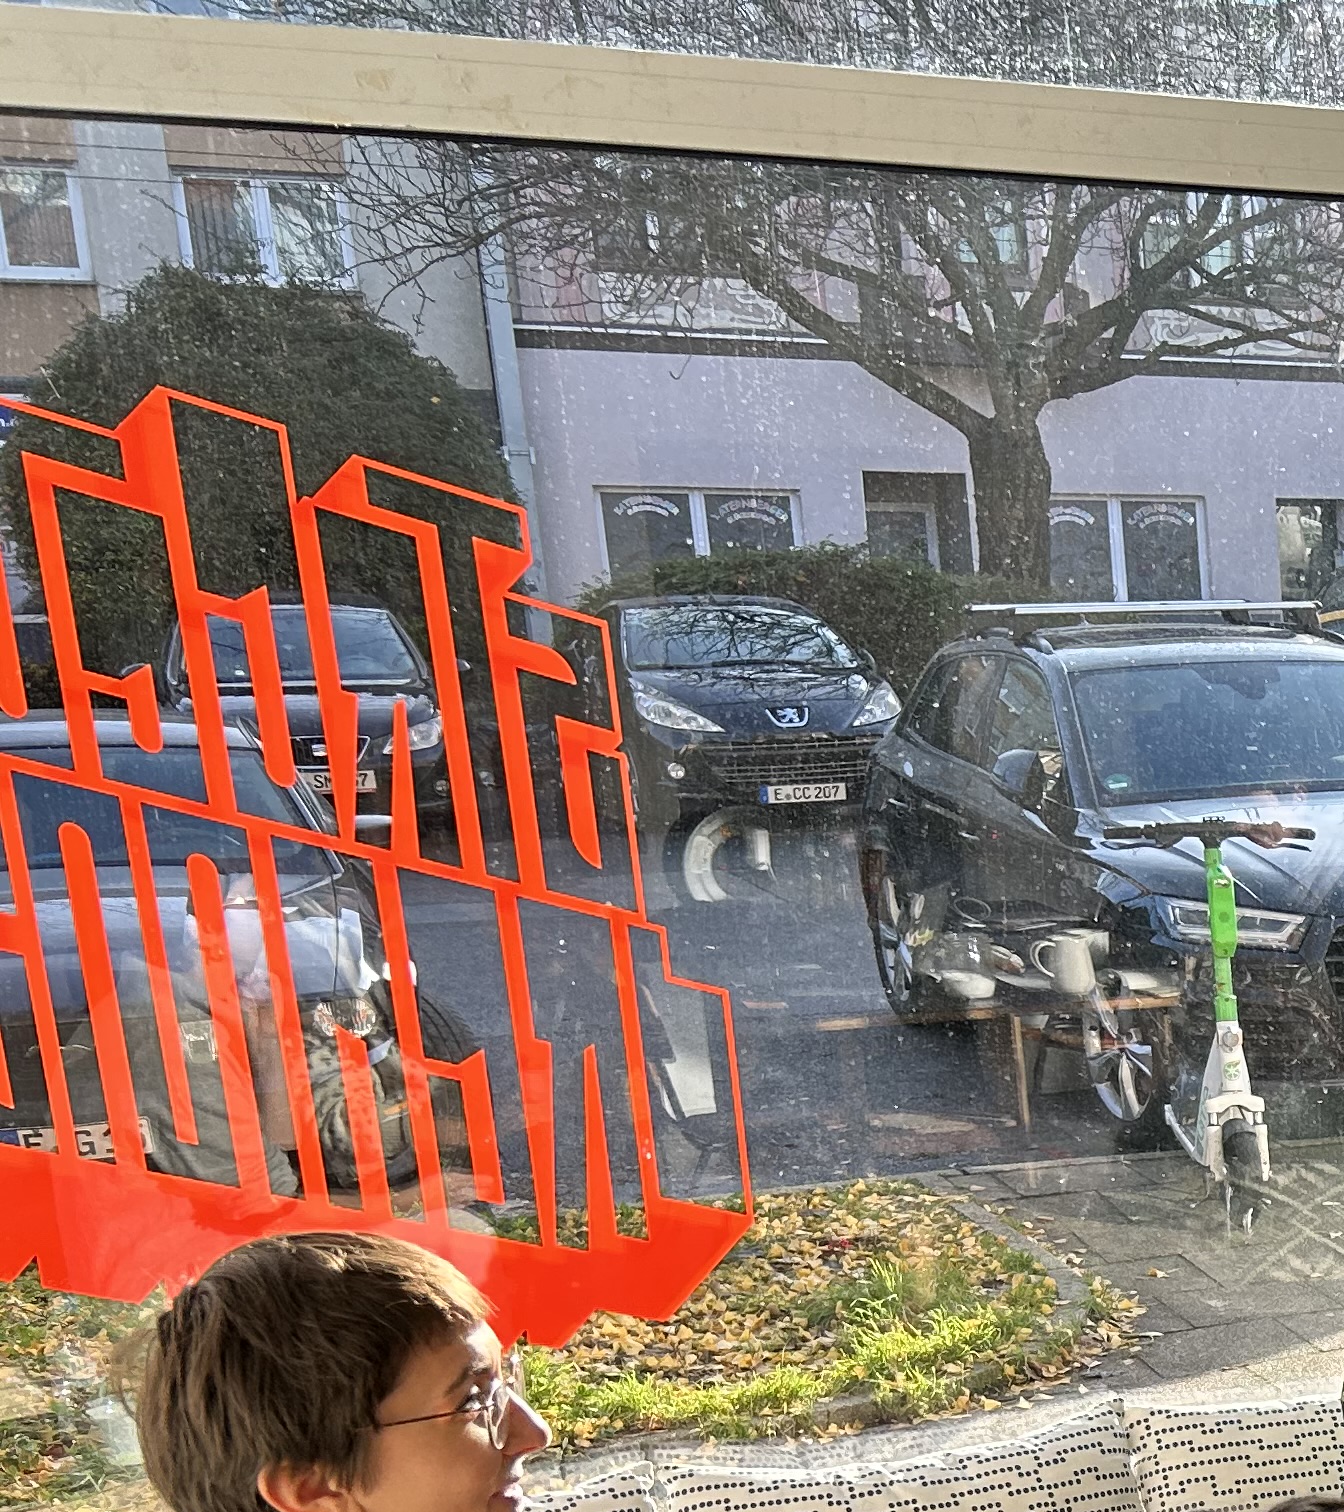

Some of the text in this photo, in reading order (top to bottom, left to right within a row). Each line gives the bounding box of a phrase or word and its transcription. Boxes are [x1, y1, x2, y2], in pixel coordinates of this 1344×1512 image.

[774, 785, 840, 801] E CC 207
